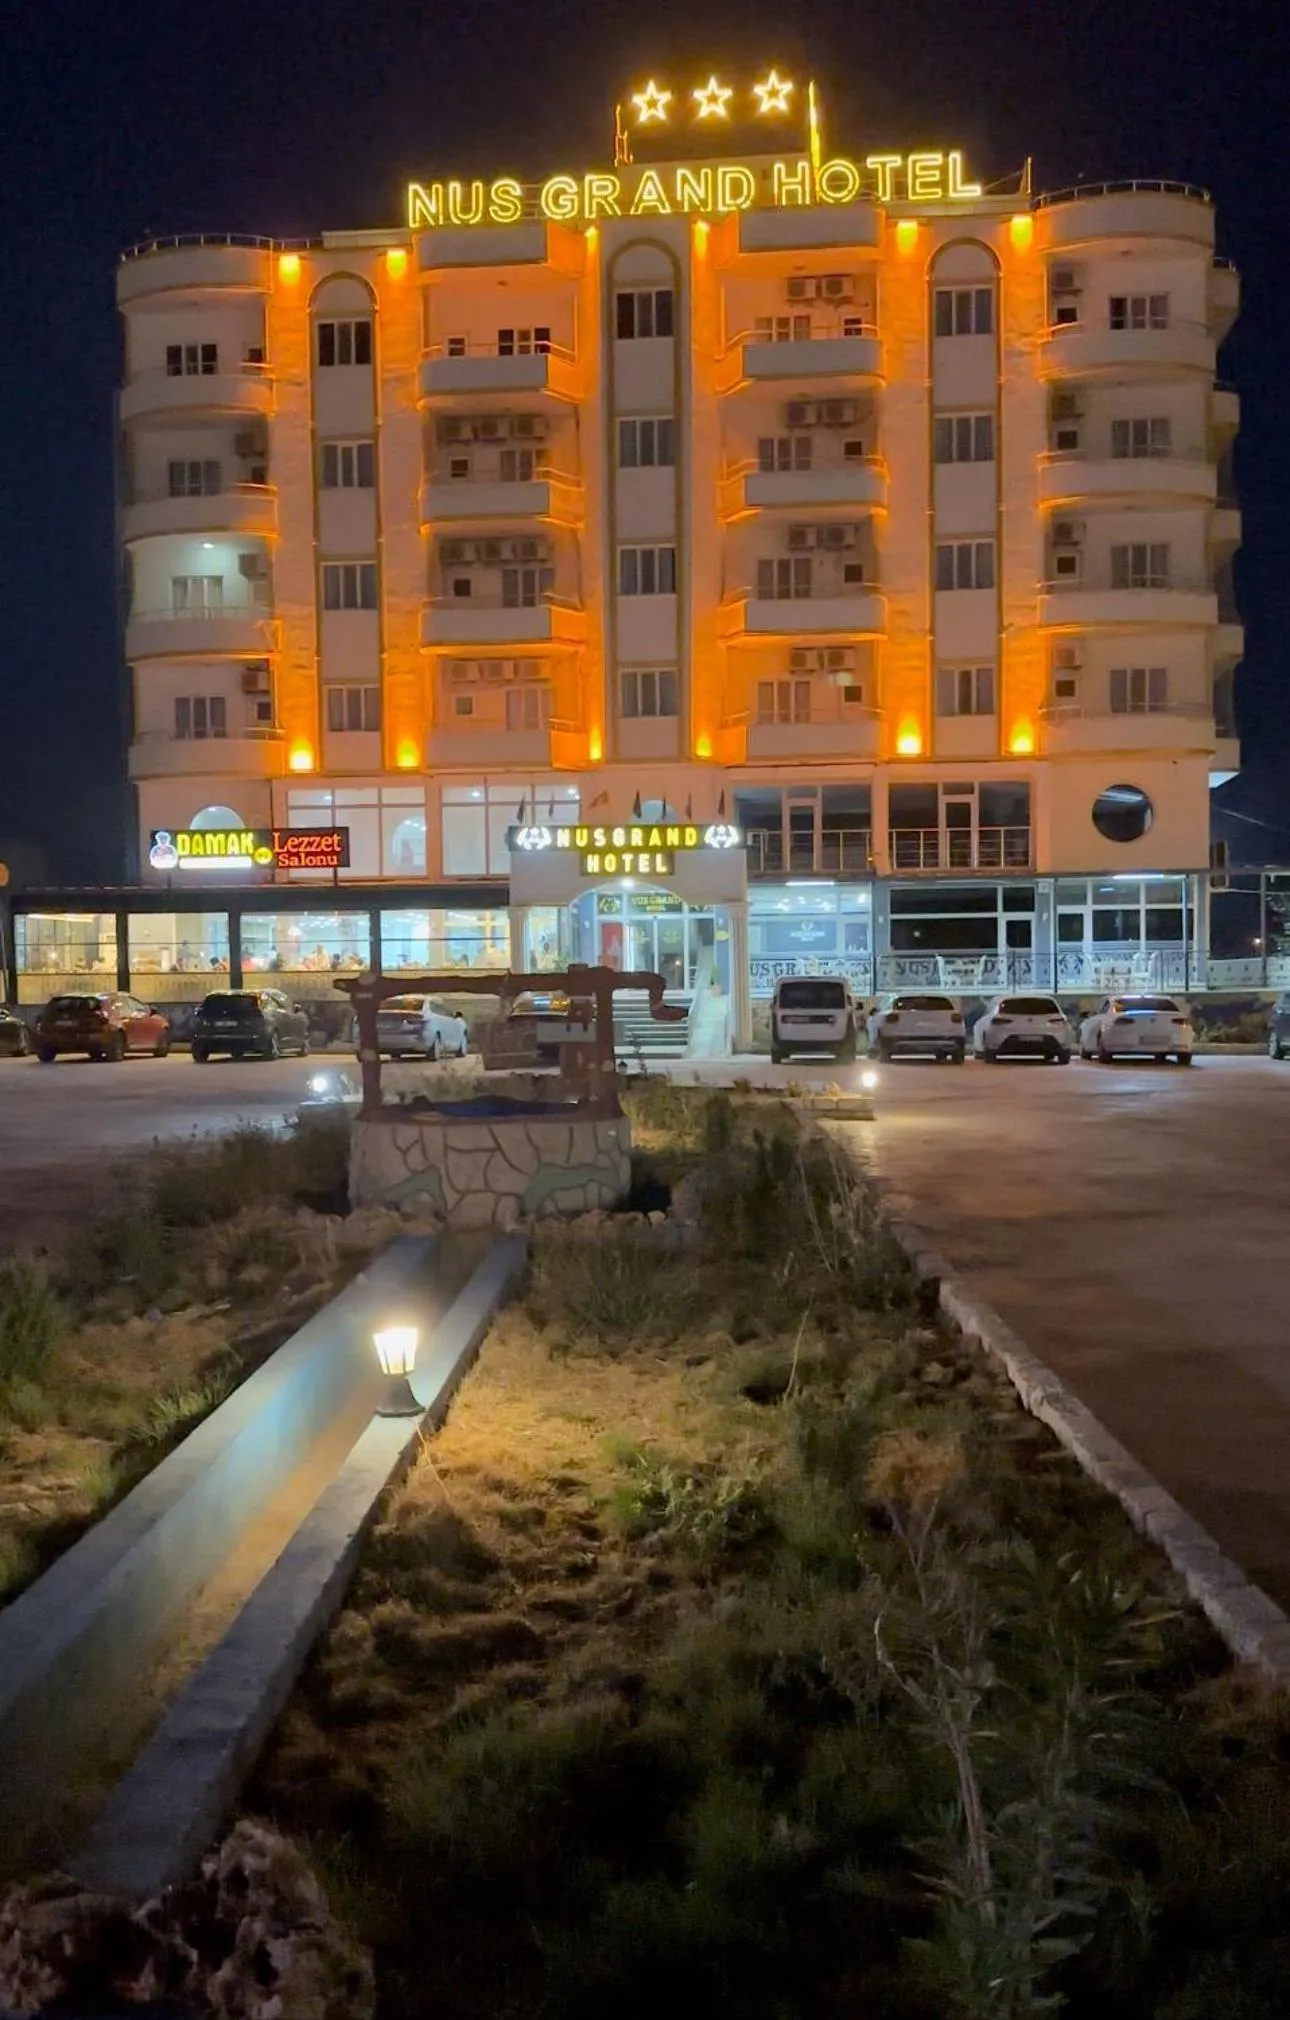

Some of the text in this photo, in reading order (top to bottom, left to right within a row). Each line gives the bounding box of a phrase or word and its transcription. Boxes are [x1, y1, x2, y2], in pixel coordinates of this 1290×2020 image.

[408, 150, 983, 229] NUS GRAND HOTEL
[176, 832, 254, 856] DAMAK
[272, 831, 342, 852] Lezzet
[556, 827, 698, 848] NUSGRAND
[278, 853, 338, 867] Salonu
[586, 853, 668, 874] HOTEL
